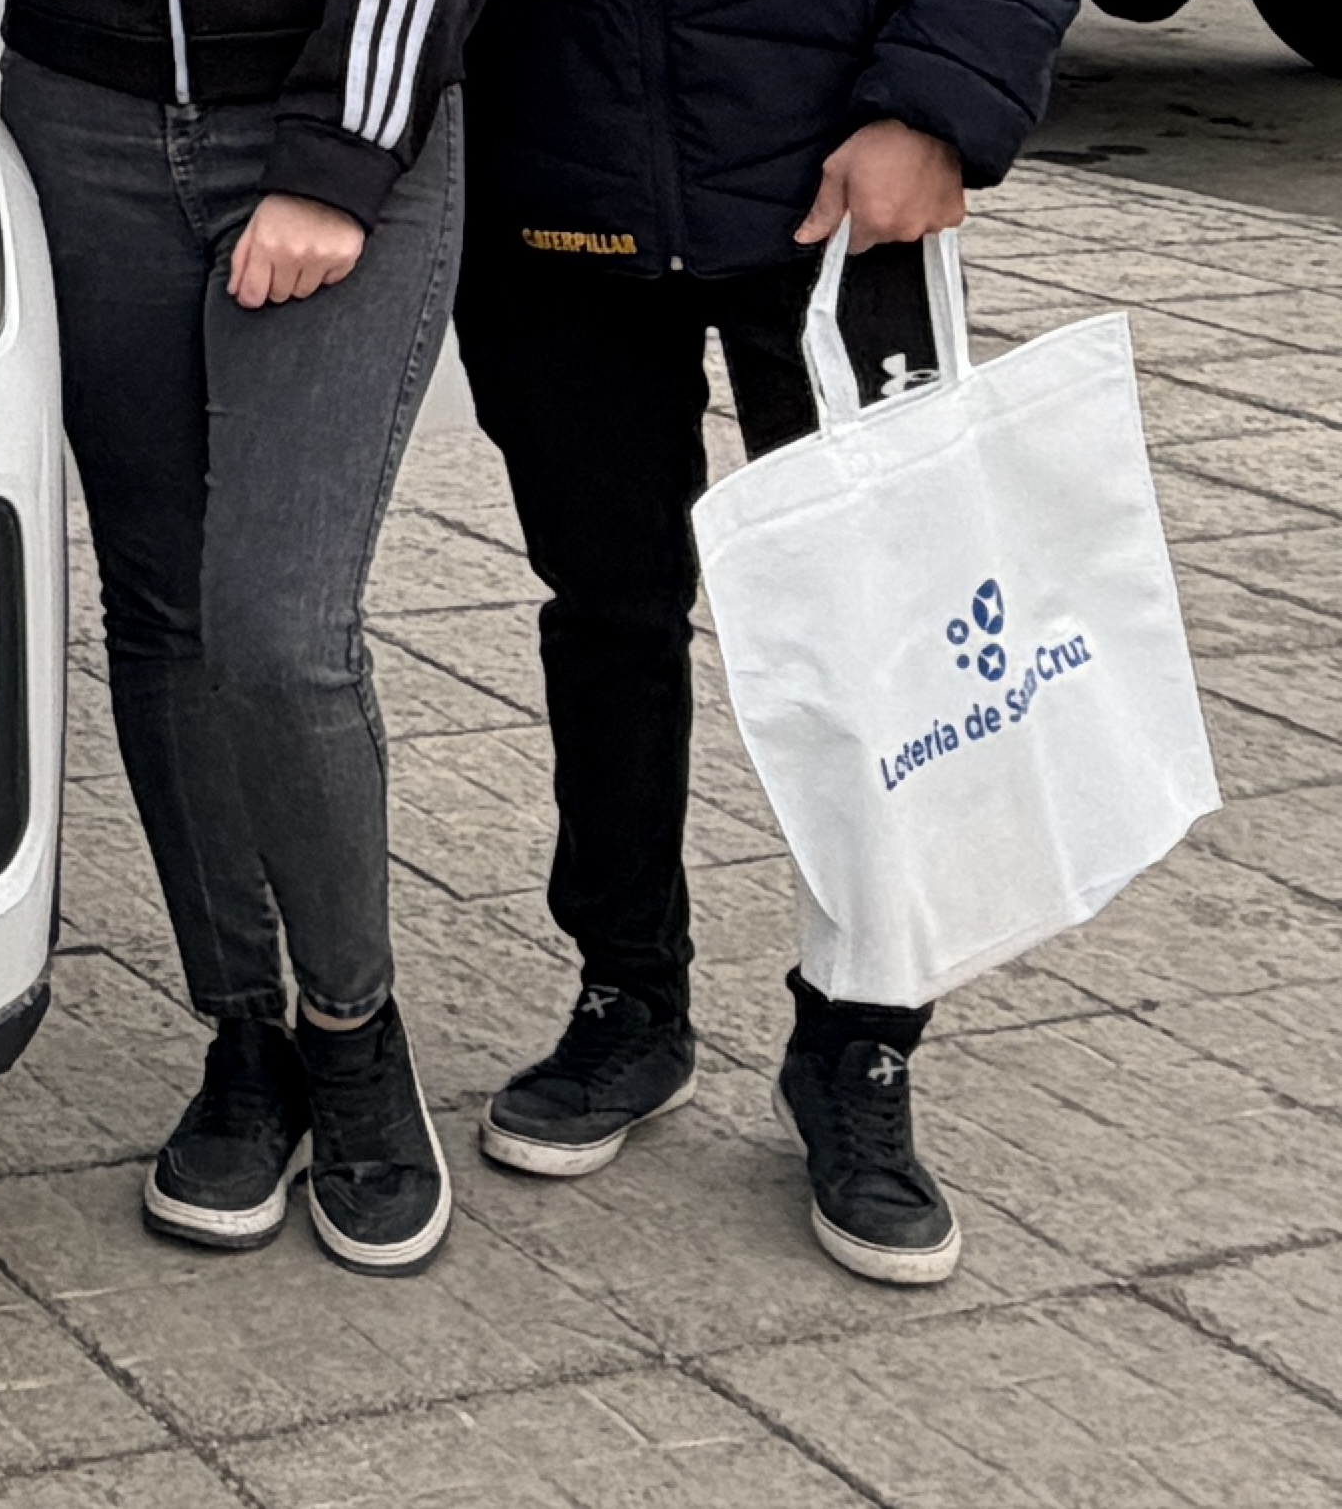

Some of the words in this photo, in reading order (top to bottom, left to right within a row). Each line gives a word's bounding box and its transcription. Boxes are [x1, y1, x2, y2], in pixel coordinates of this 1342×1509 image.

[522, 228, 637, 254] CATERPILLAR
[965, 703, 1001, 741] de
[1035, 634, 1092, 680] Cruz
